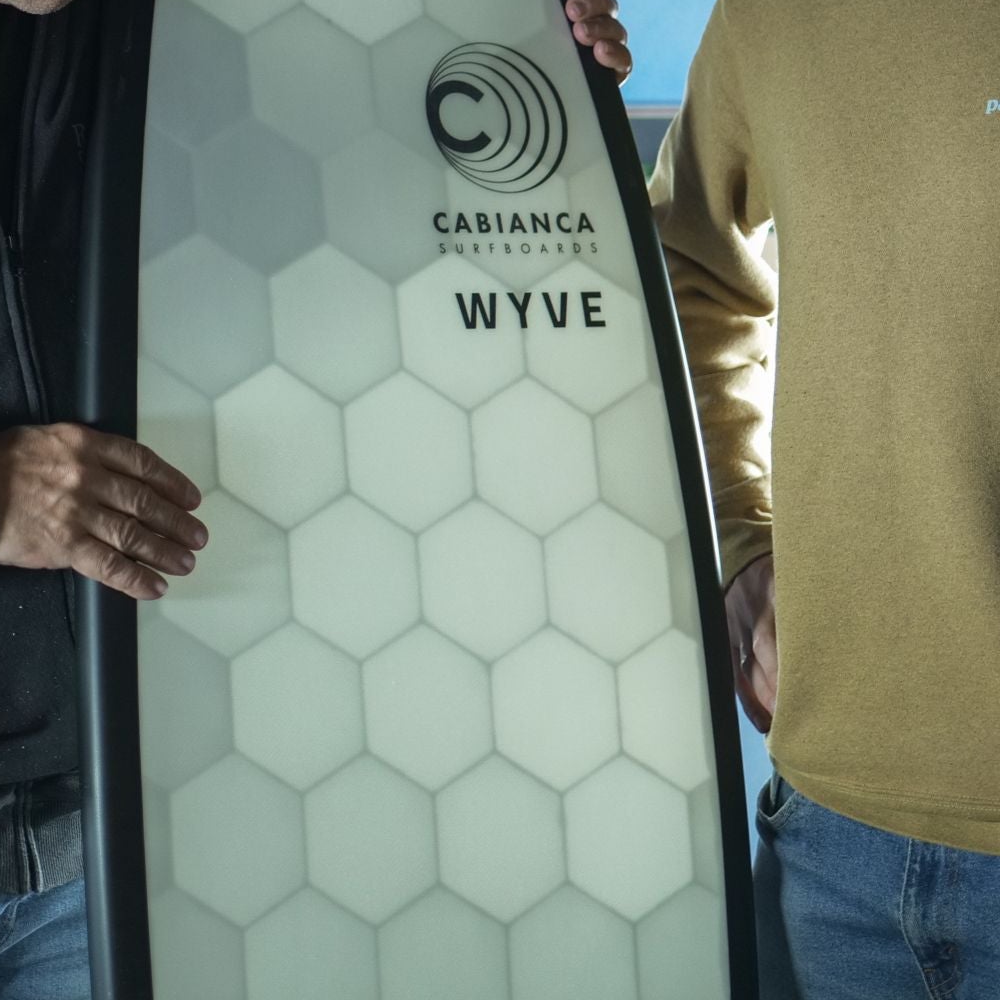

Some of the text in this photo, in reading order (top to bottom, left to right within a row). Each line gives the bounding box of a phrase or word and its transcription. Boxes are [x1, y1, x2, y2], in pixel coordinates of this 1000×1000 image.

[433, 212, 595, 234] CABIANCA
[439, 243, 598, 254] SURFBOARDS
[455, 291, 606, 329] WYVE
